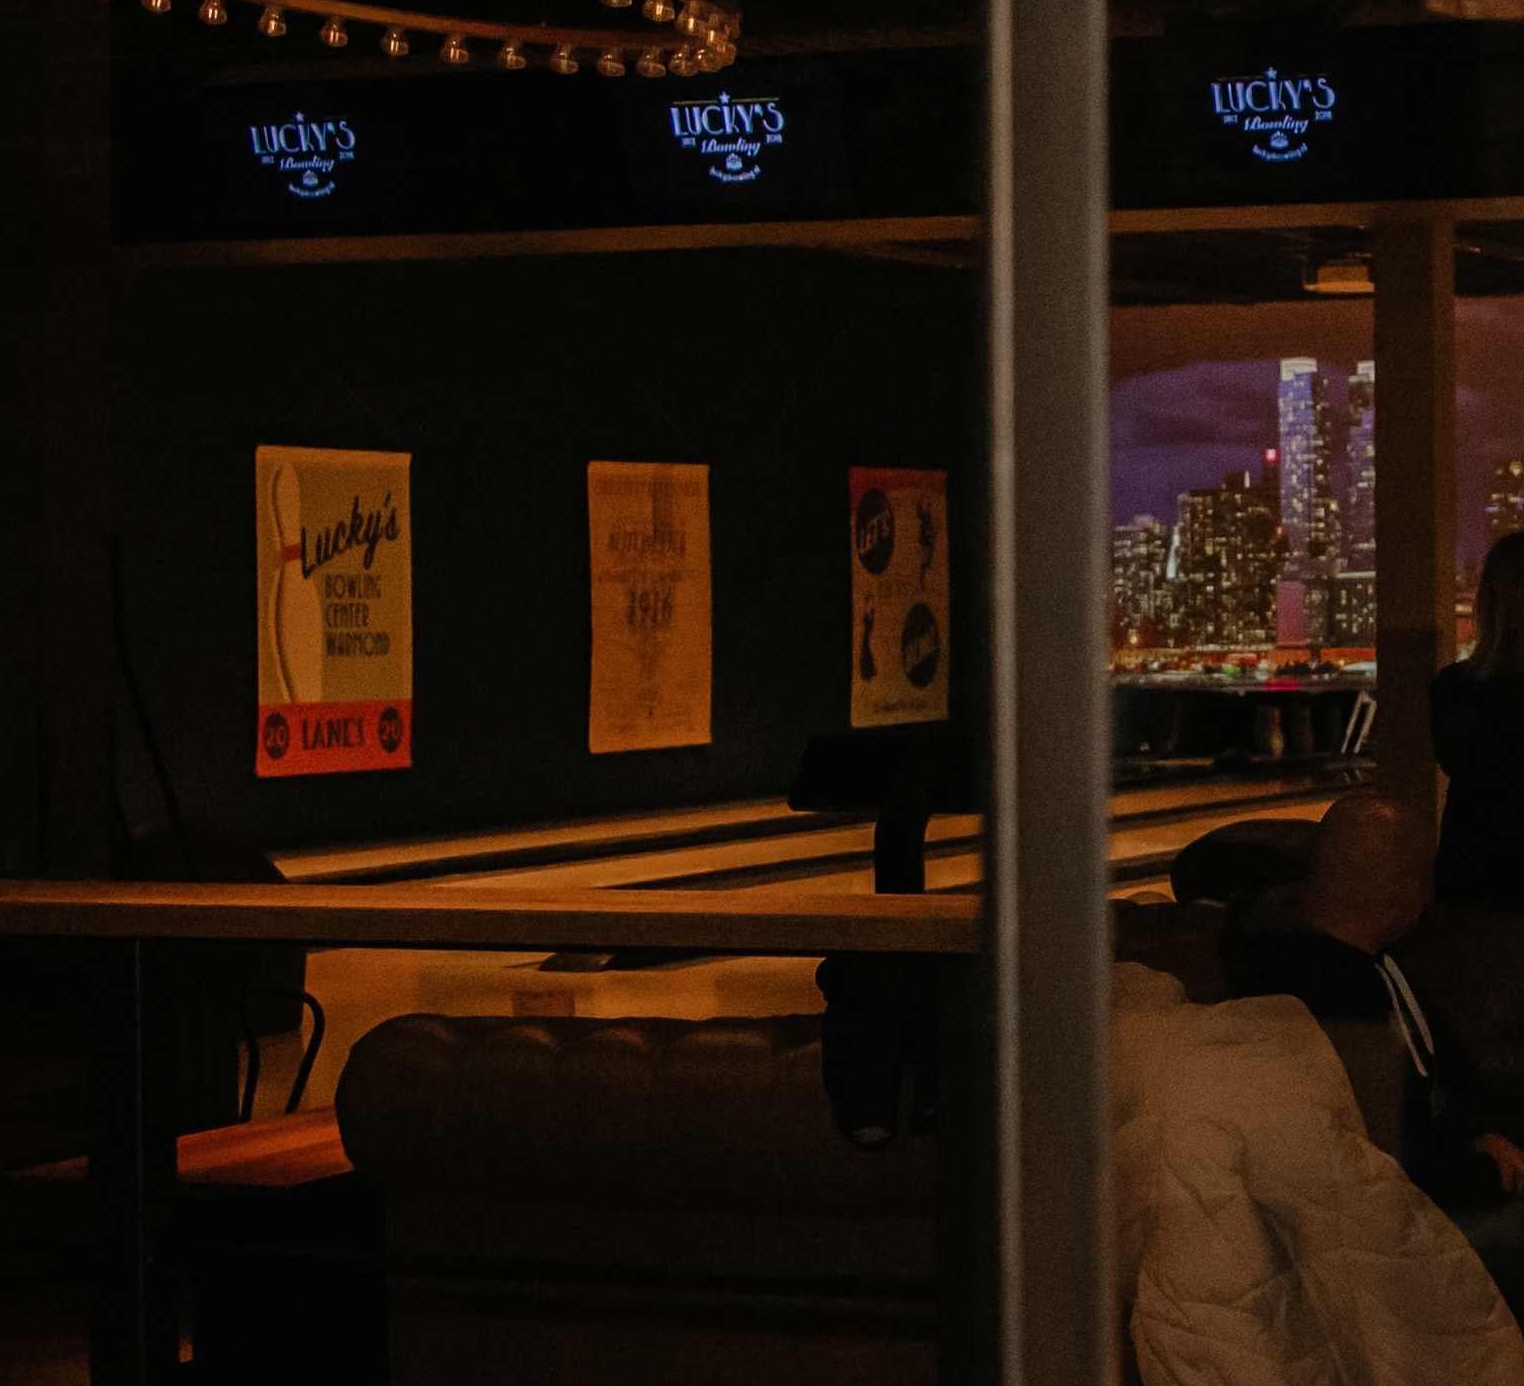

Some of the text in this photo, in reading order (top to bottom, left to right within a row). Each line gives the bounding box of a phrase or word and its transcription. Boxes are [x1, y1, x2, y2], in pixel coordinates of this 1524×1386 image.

[1210, 78, 1336, 113] LUCKY'S
[670, 102, 784, 137] LUCKY'S
[1244, 114, 1309, 134] Bowling
[251, 120, 356, 154] LUCKY'S
[700, 136, 762, 156] Bowling
[299, 491, 400, 579] Lucky's
[324, 573, 382, 599] BOWLING
[324, 602, 370, 628] CENTER
[301, 716, 366, 751] LANES
